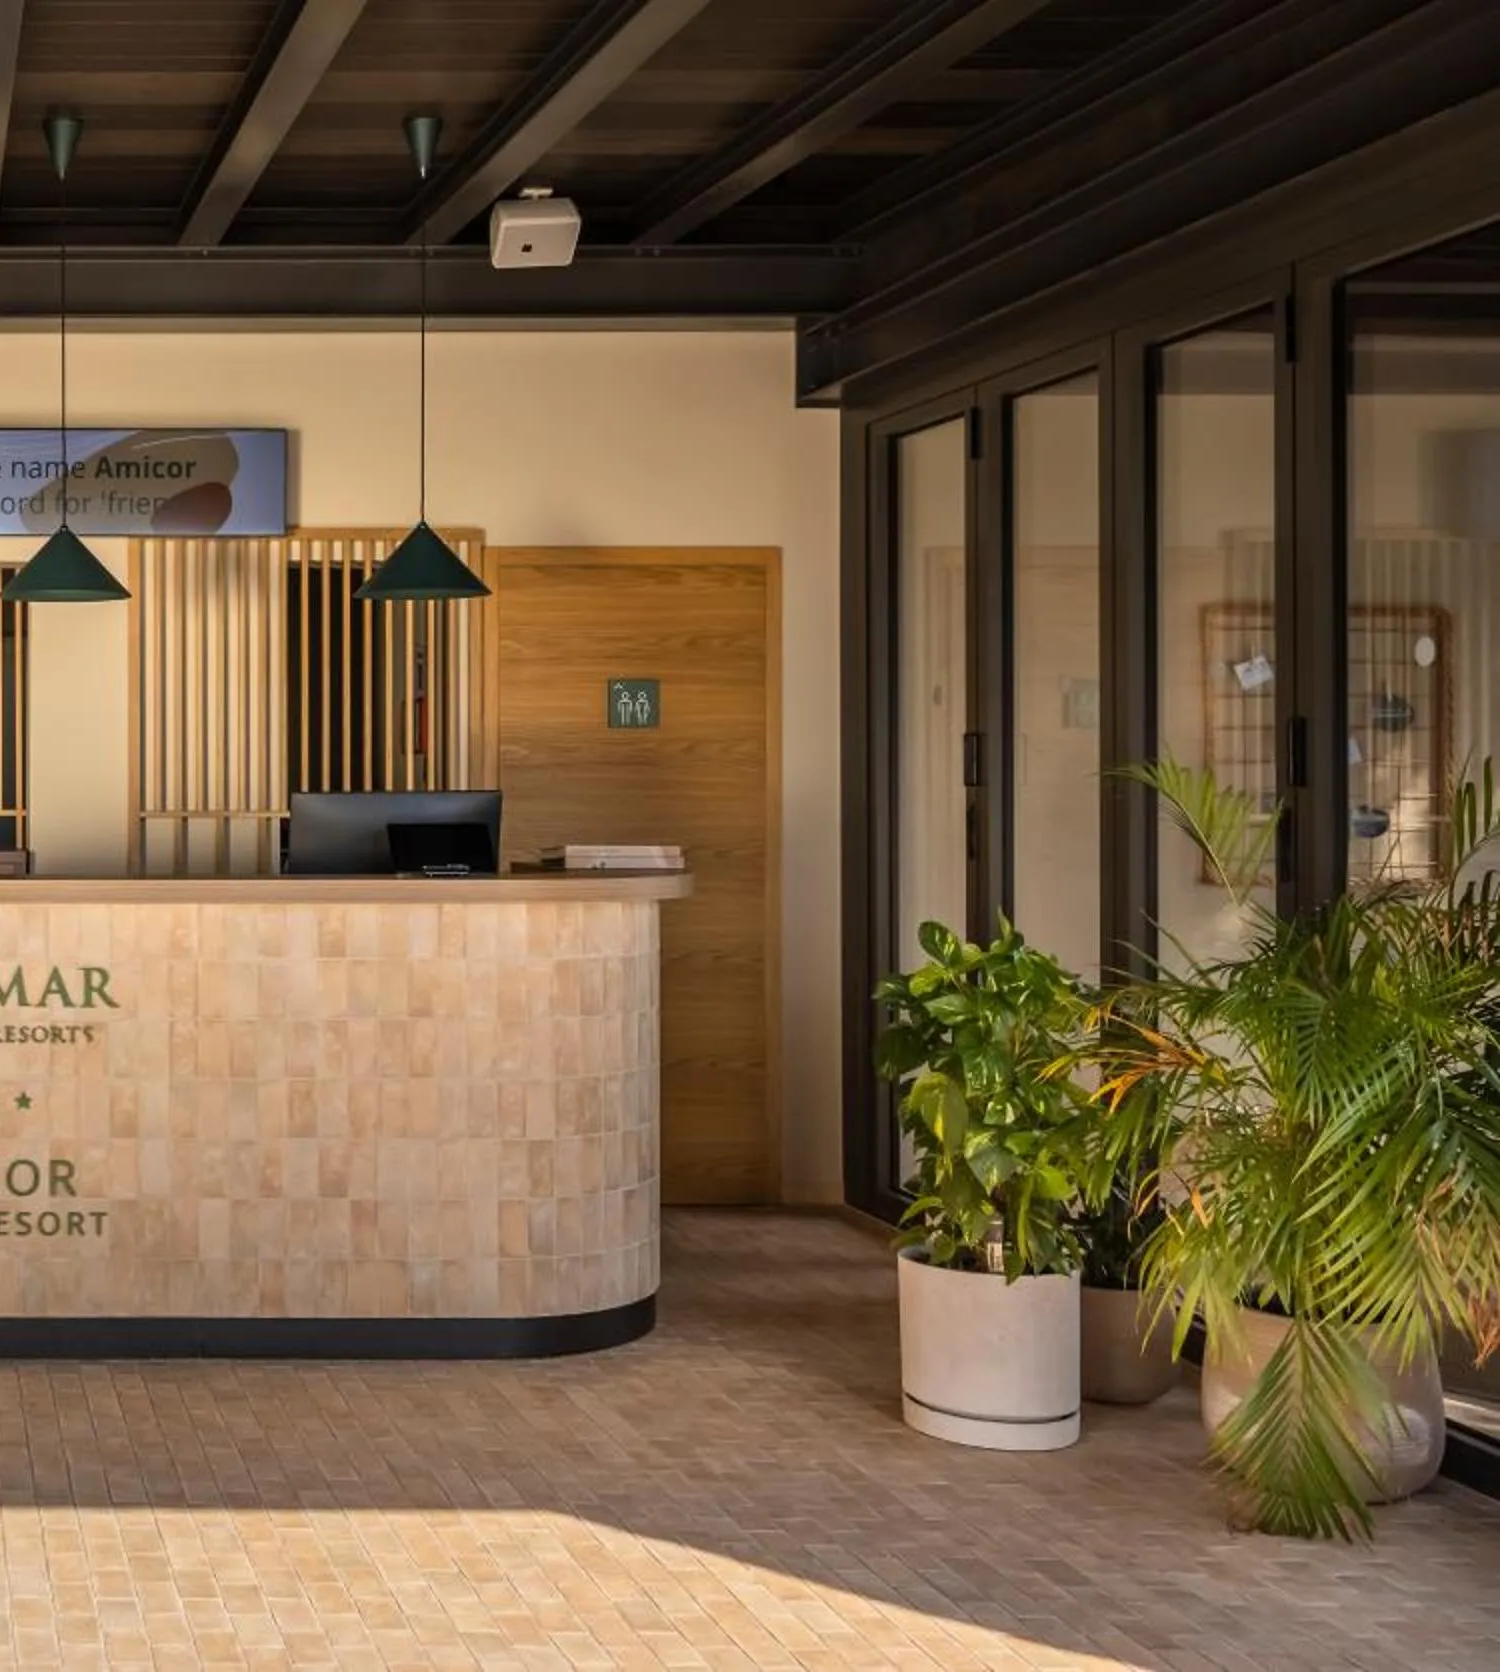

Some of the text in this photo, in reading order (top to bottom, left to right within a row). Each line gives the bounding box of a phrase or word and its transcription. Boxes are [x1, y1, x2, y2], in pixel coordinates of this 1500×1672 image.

[11, 460, 86, 479] name
[94, 455, 197, 479] Amicor
[55, 490, 91, 515] for
